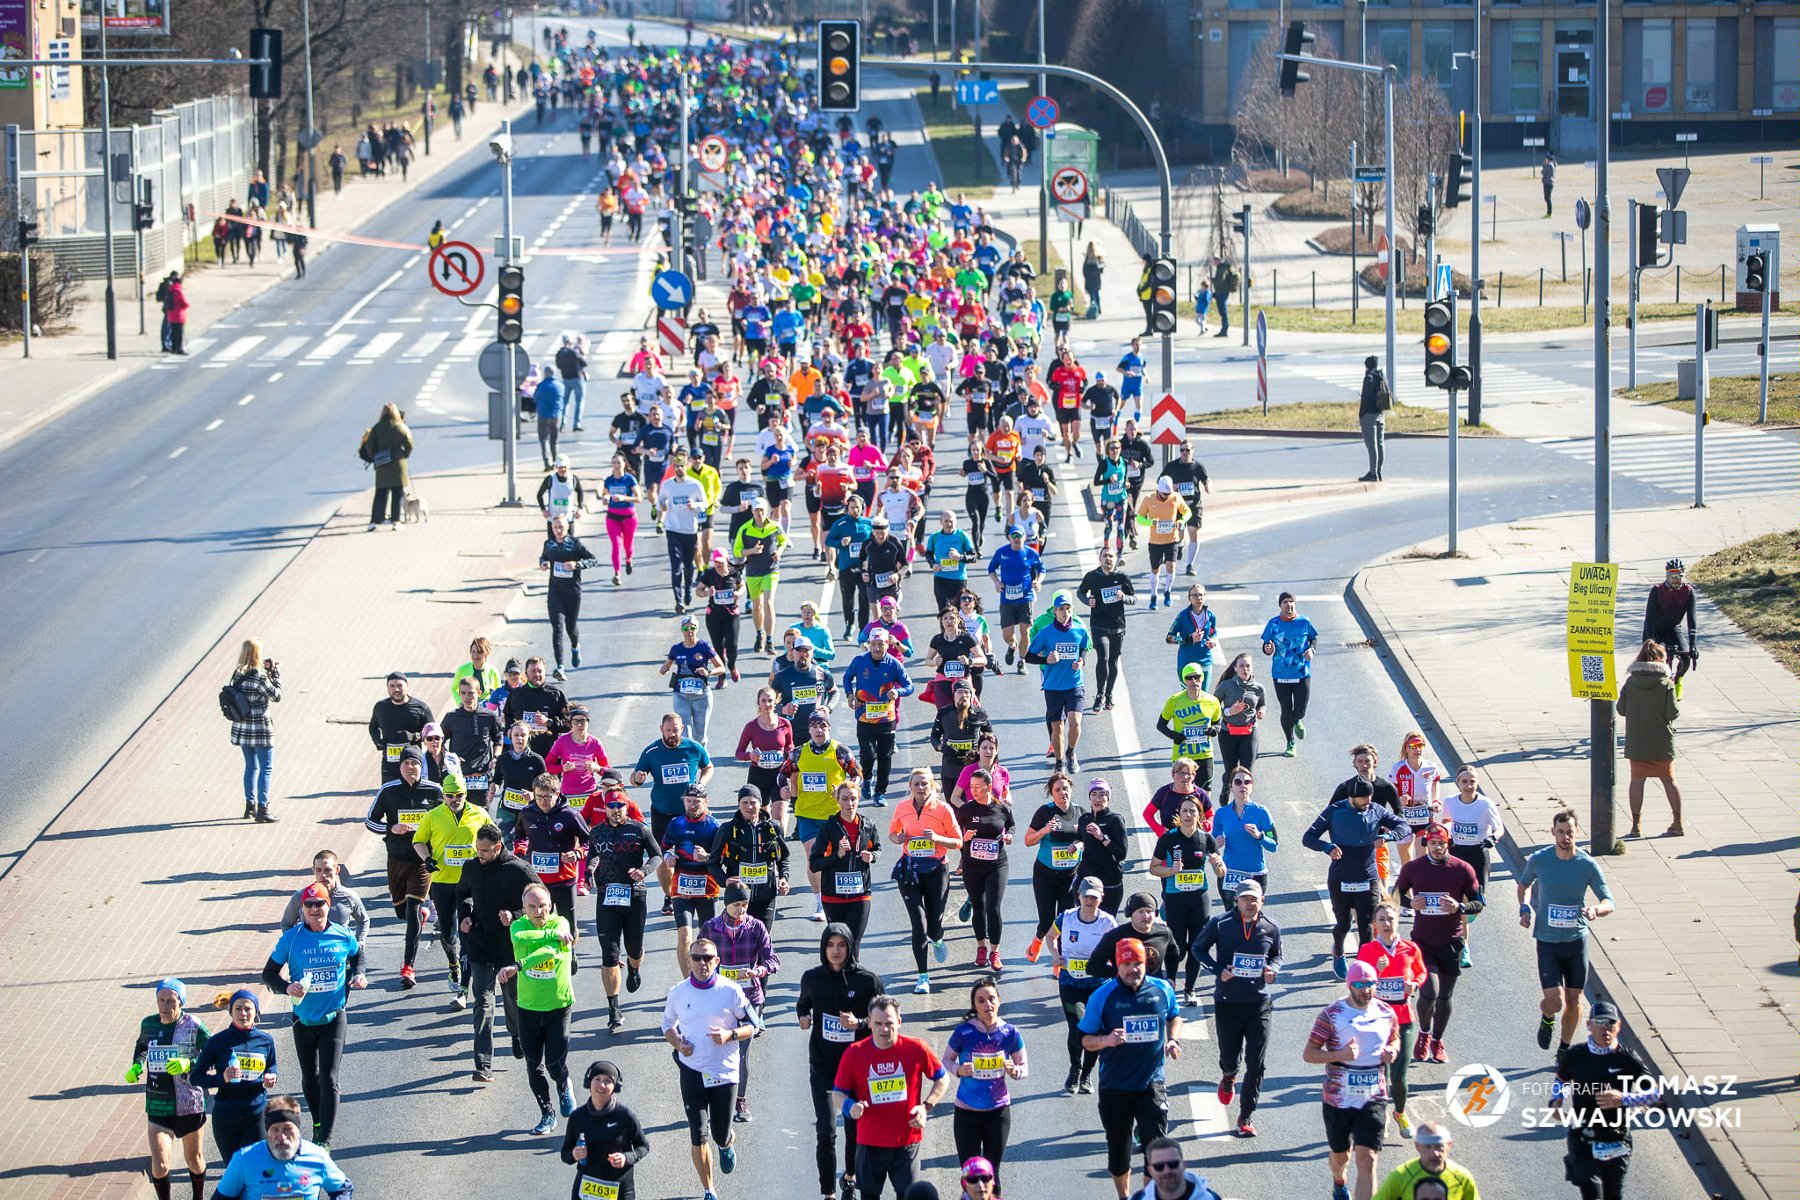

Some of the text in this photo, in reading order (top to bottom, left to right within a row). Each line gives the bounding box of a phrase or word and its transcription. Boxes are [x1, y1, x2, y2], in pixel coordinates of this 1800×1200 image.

[1580, 567, 1610, 580] UWAGA
[1574, 583, 1612, 597] Bieg Uliczny
[1570, 626, 1612, 637] ZAMKNIĘTA
[1175, 704, 1202, 718] RUN
[1178, 741, 1210, 755] FUN
[309, 956, 336, 964] PEGAZ
[1074, 961, 1086, 969] 13
[1240, 958, 1256, 966] 496
[1131, 1021, 1148, 1030] 710
[149, 1051, 171, 1060] 1181
[980, 1059, 996, 1067] 713
[1351, 1074, 1374, 1084] 1049
[877, 1080, 894, 1090] 877
[585, 1183, 609, 1196] 2163
